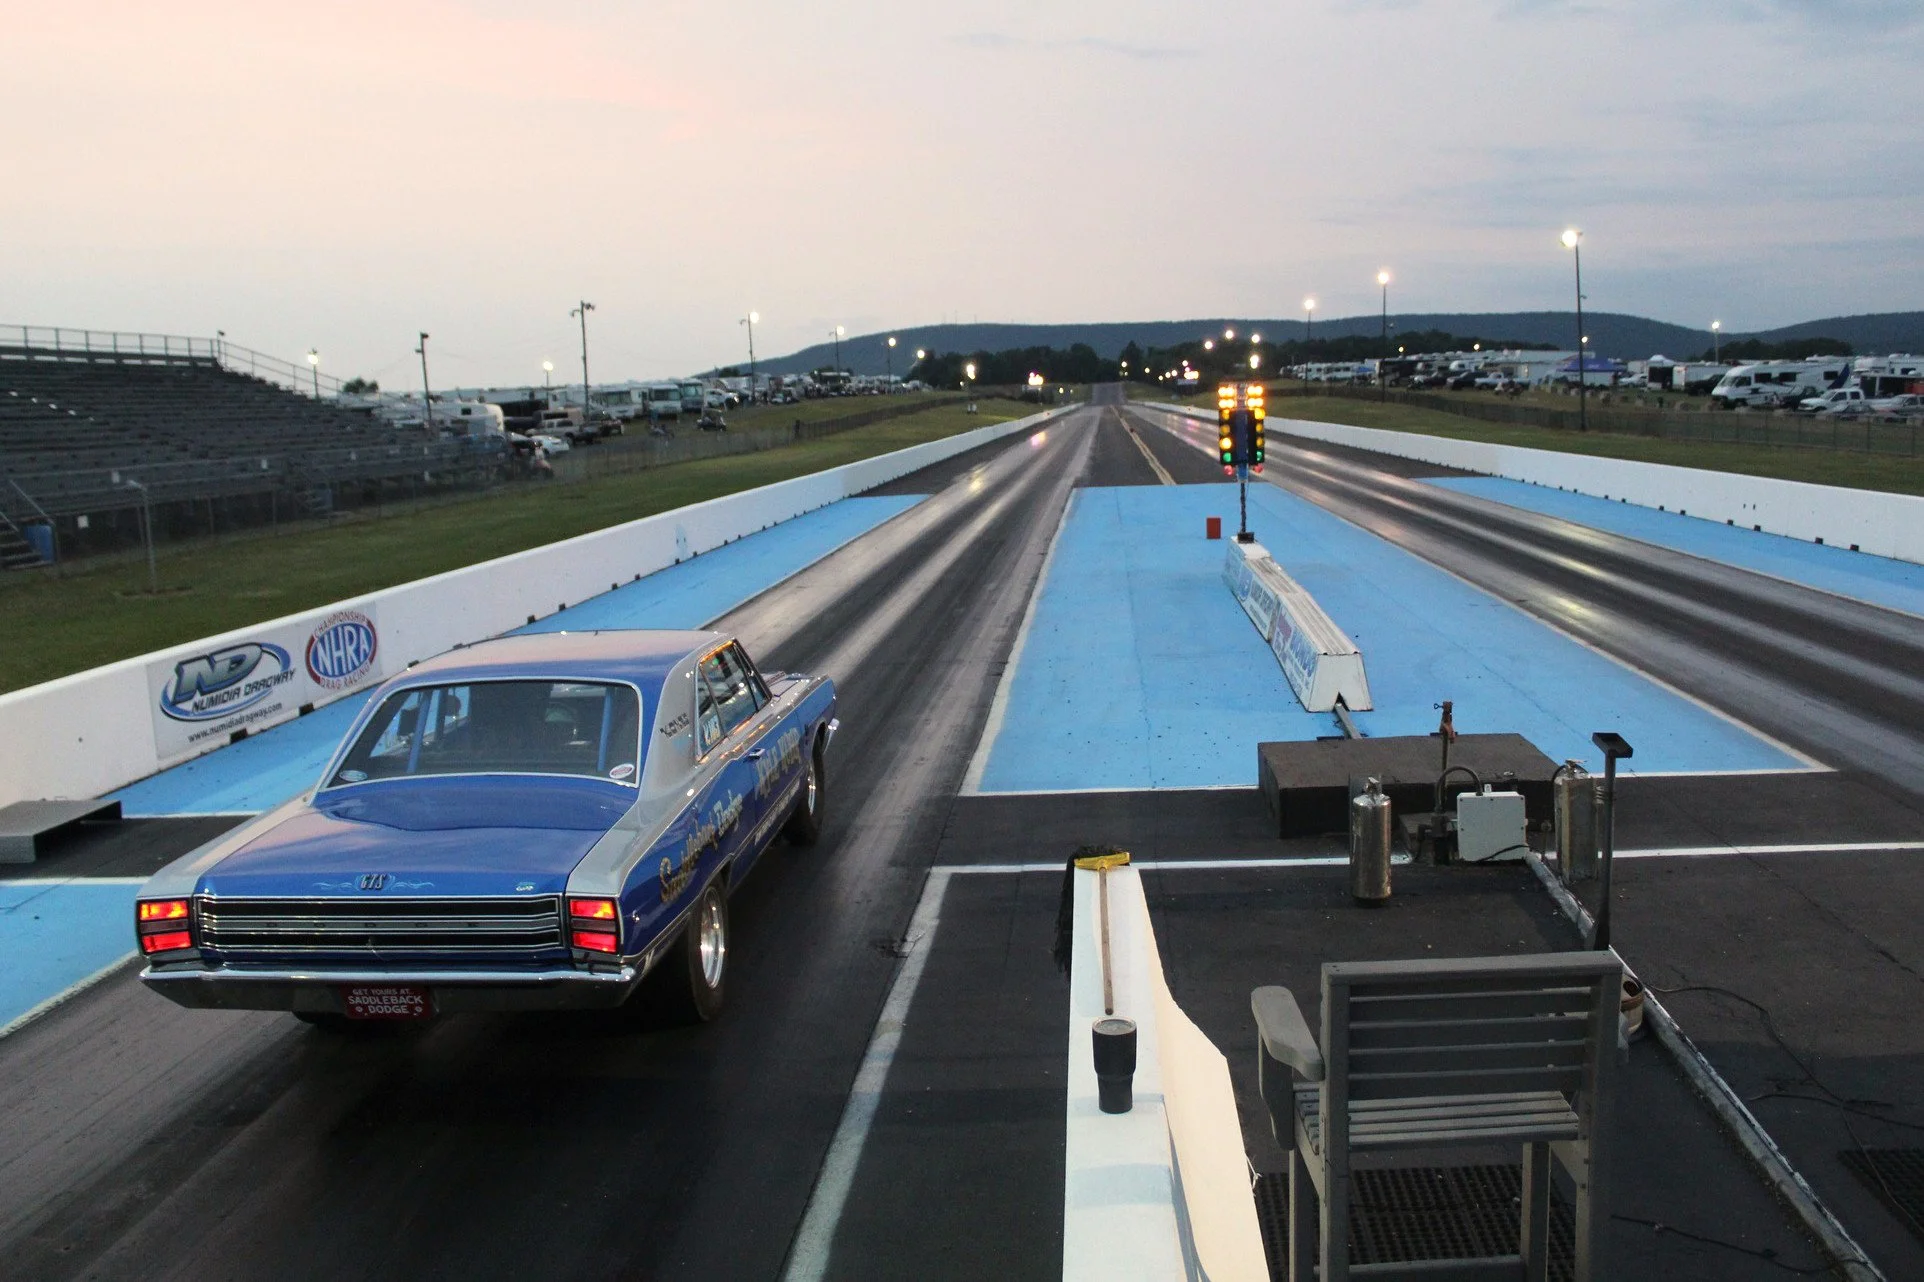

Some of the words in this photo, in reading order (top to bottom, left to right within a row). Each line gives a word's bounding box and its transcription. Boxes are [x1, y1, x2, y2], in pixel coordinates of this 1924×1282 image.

[313, 610, 368, 638] CHAMPIONSHIP
[316, 624, 370, 677] NHRA
[320, 677, 342, 690] DRAG
[343, 661, 371, 689] RACING
[191, 687, 242, 713] NUMIDIA
[243, 668, 296, 697] DRAGWAY
[187, 702, 283, 743] www.numidiadragway.com
[347, 995, 424, 1005] SADDLEBACK
[352, 988, 368, 996] GET
[370, 988, 398, 996] YOURS
[367, 1005, 410, 1014] DODGE
